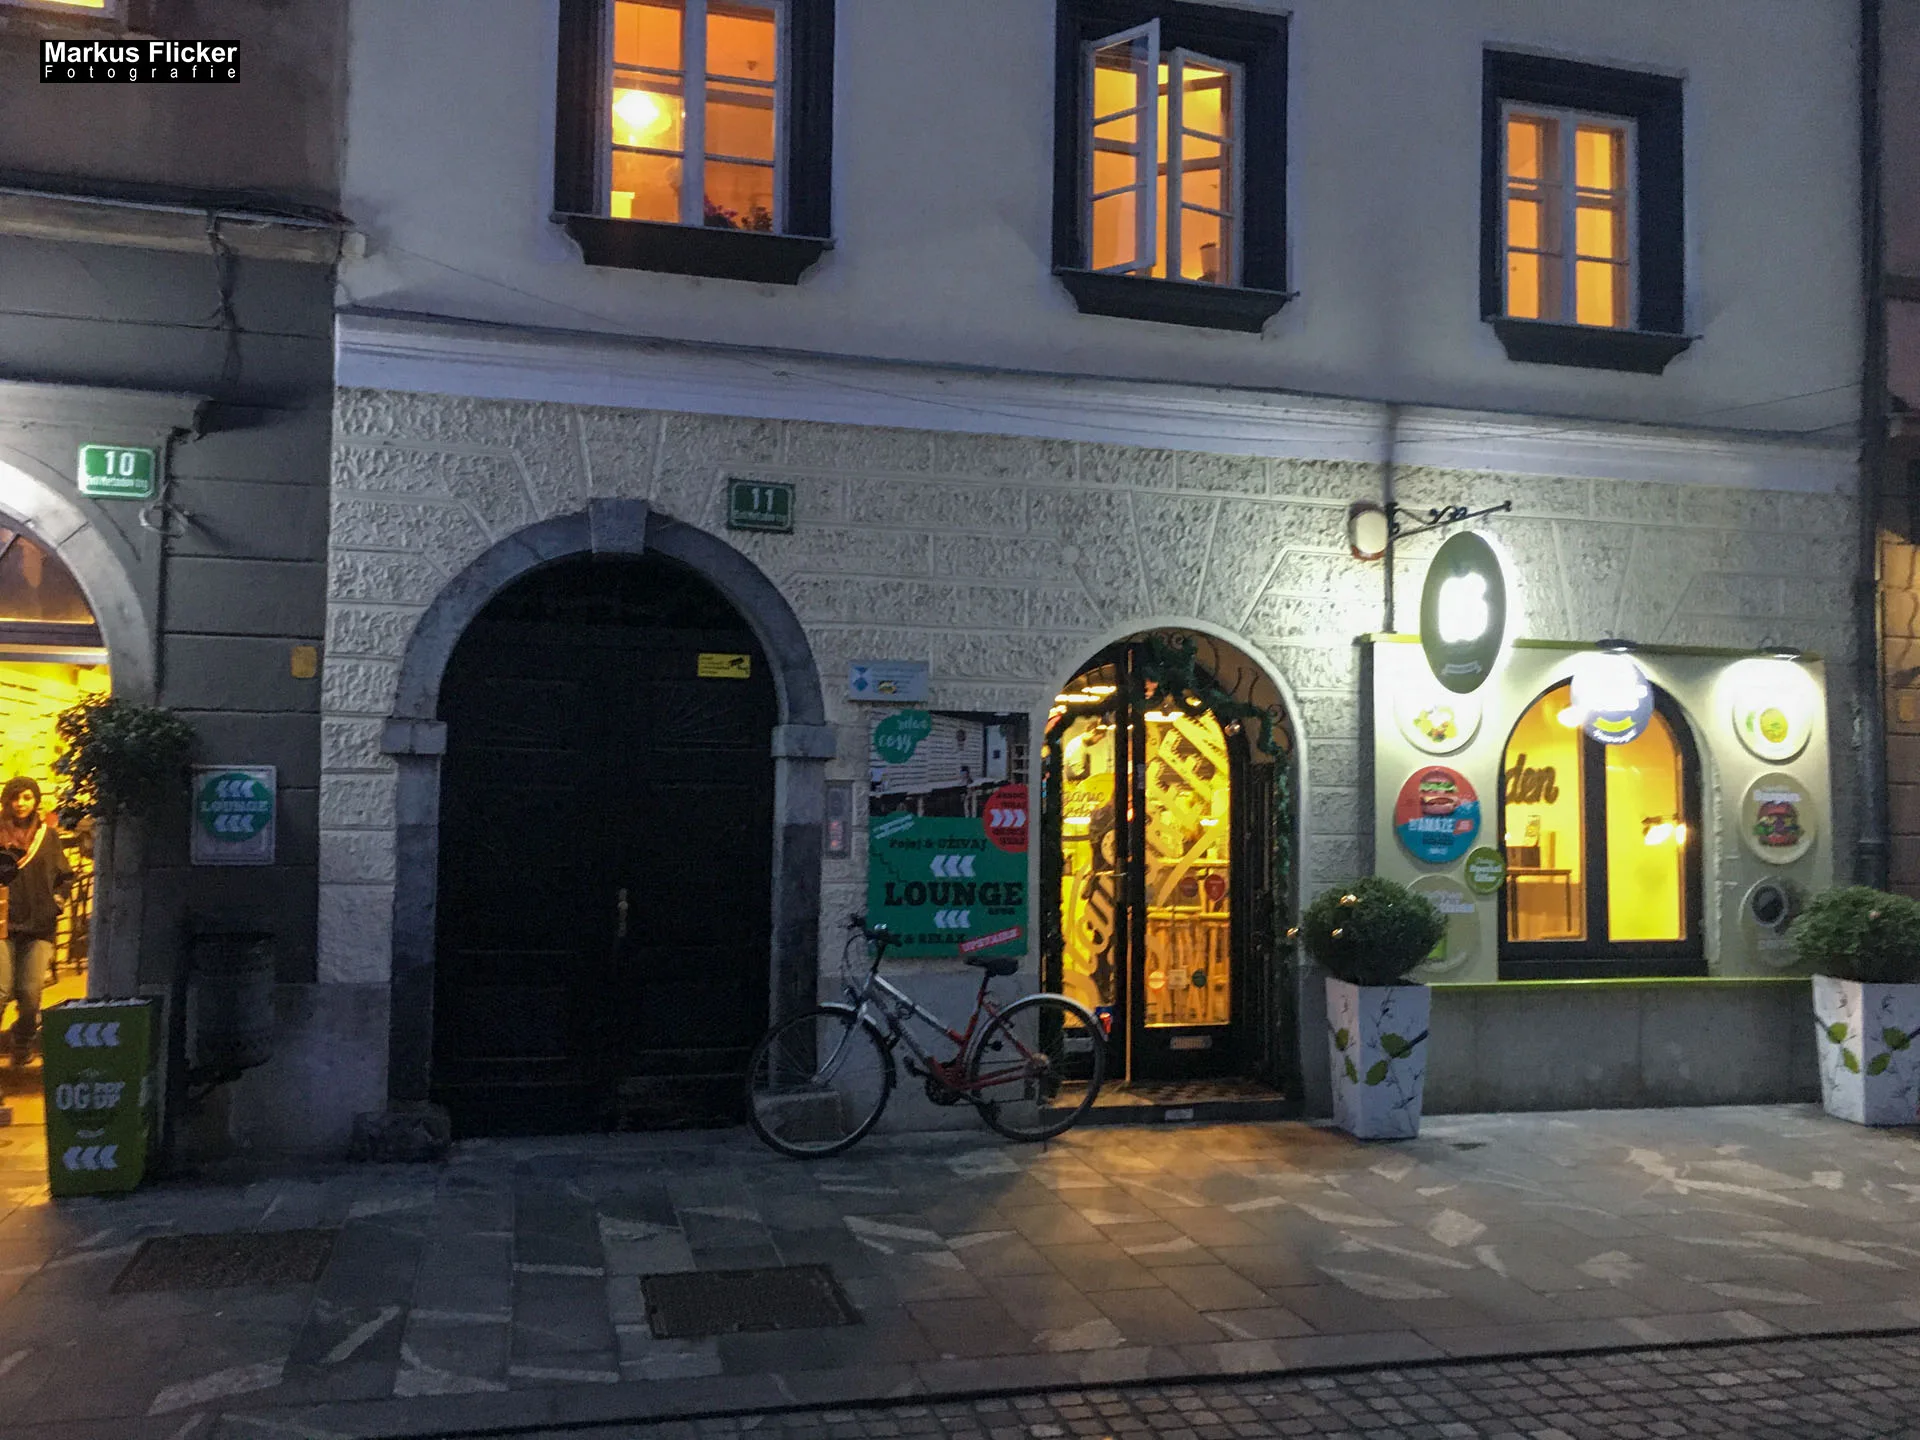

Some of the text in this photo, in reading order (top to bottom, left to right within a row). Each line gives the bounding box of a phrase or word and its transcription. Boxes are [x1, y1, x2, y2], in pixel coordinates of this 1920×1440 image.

[104, 451, 135, 476] 10
[752, 487, 774, 511] 11
[878, 733, 912, 754] cozy
[884, 881, 1024, 907] LOUNGE
